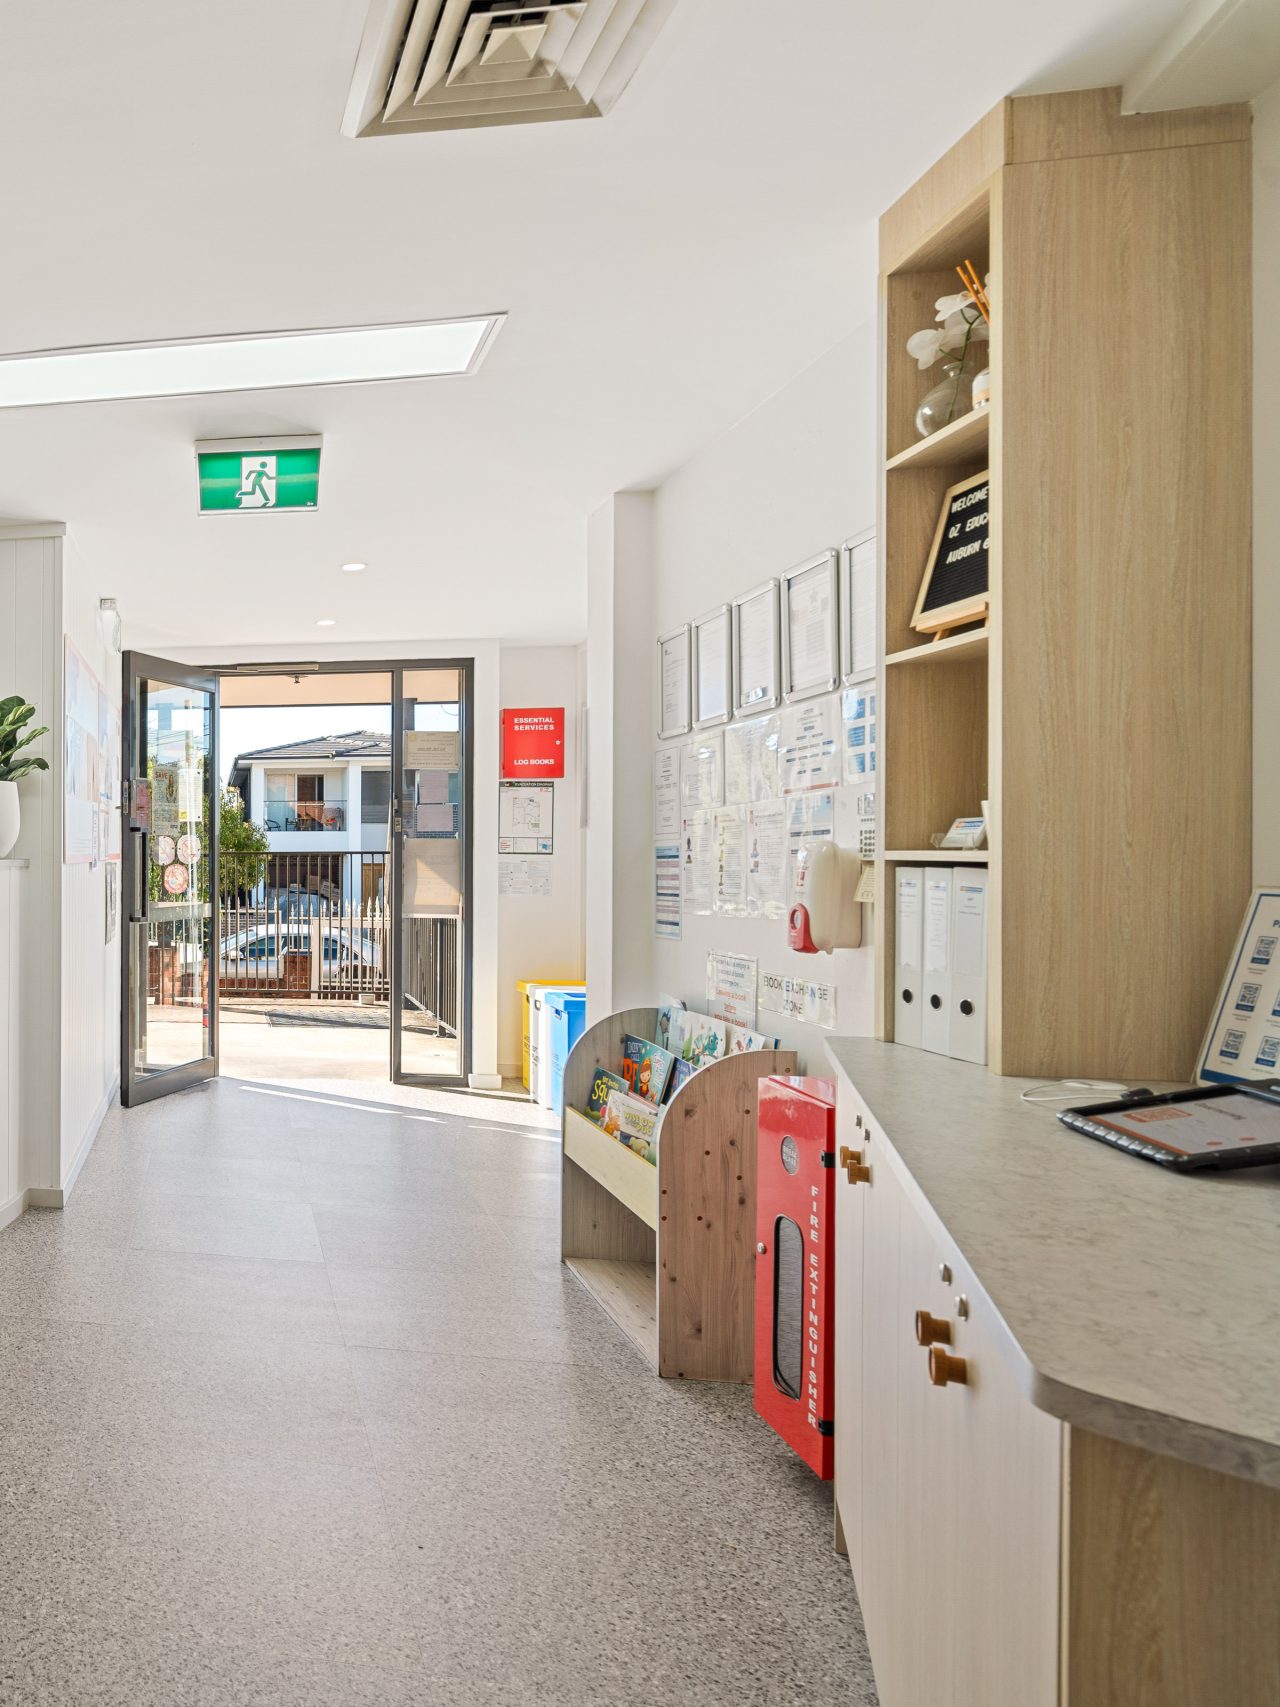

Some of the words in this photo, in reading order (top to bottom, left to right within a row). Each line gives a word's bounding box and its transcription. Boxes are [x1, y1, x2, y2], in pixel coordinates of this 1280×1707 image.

[951, 486, 989, 513] WELCOME
[965, 512, 989, 531] EDUC
[946, 540, 981, 564] AUBURN
[764, 976, 783, 991] BOOK
[785, 980, 828, 1001] EXCHANGE
[784, 999, 803, 1014] ZONE
[810, 1185, 819, 1243] FIRE
[807, 1253, 819, 1429] EXTINGUISHER
